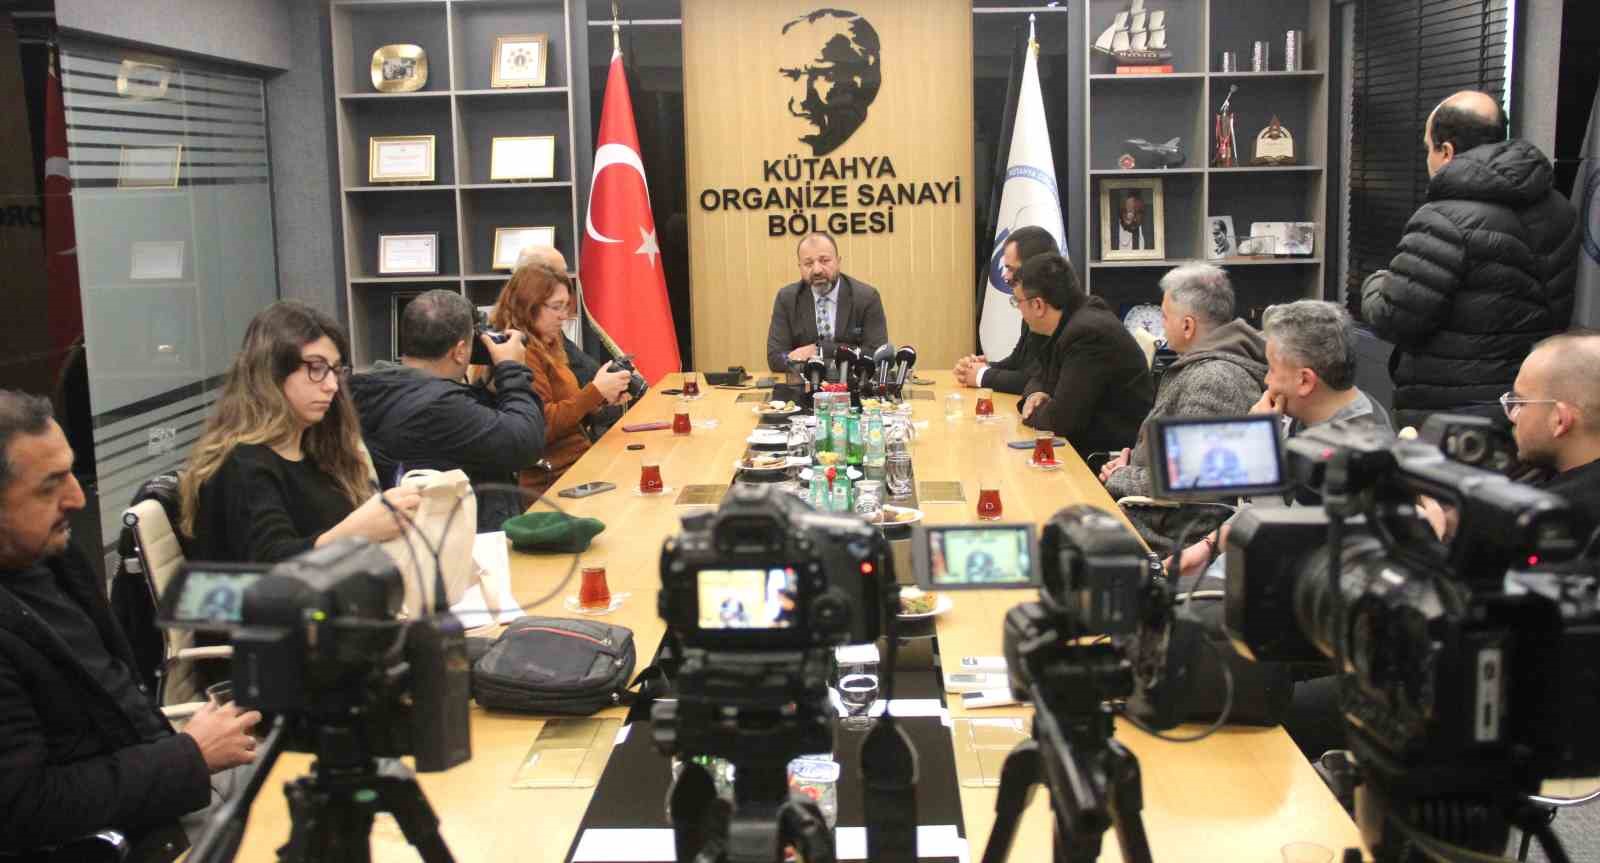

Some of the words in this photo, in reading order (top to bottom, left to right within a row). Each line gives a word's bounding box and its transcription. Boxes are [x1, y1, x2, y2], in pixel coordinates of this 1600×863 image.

[763, 154, 896, 181] KÜTAHYA
[700, 181, 848, 211] ORGANİZE
[857, 176, 960, 206] SANAYİ
[768, 208, 893, 236] BÖLGESİ
